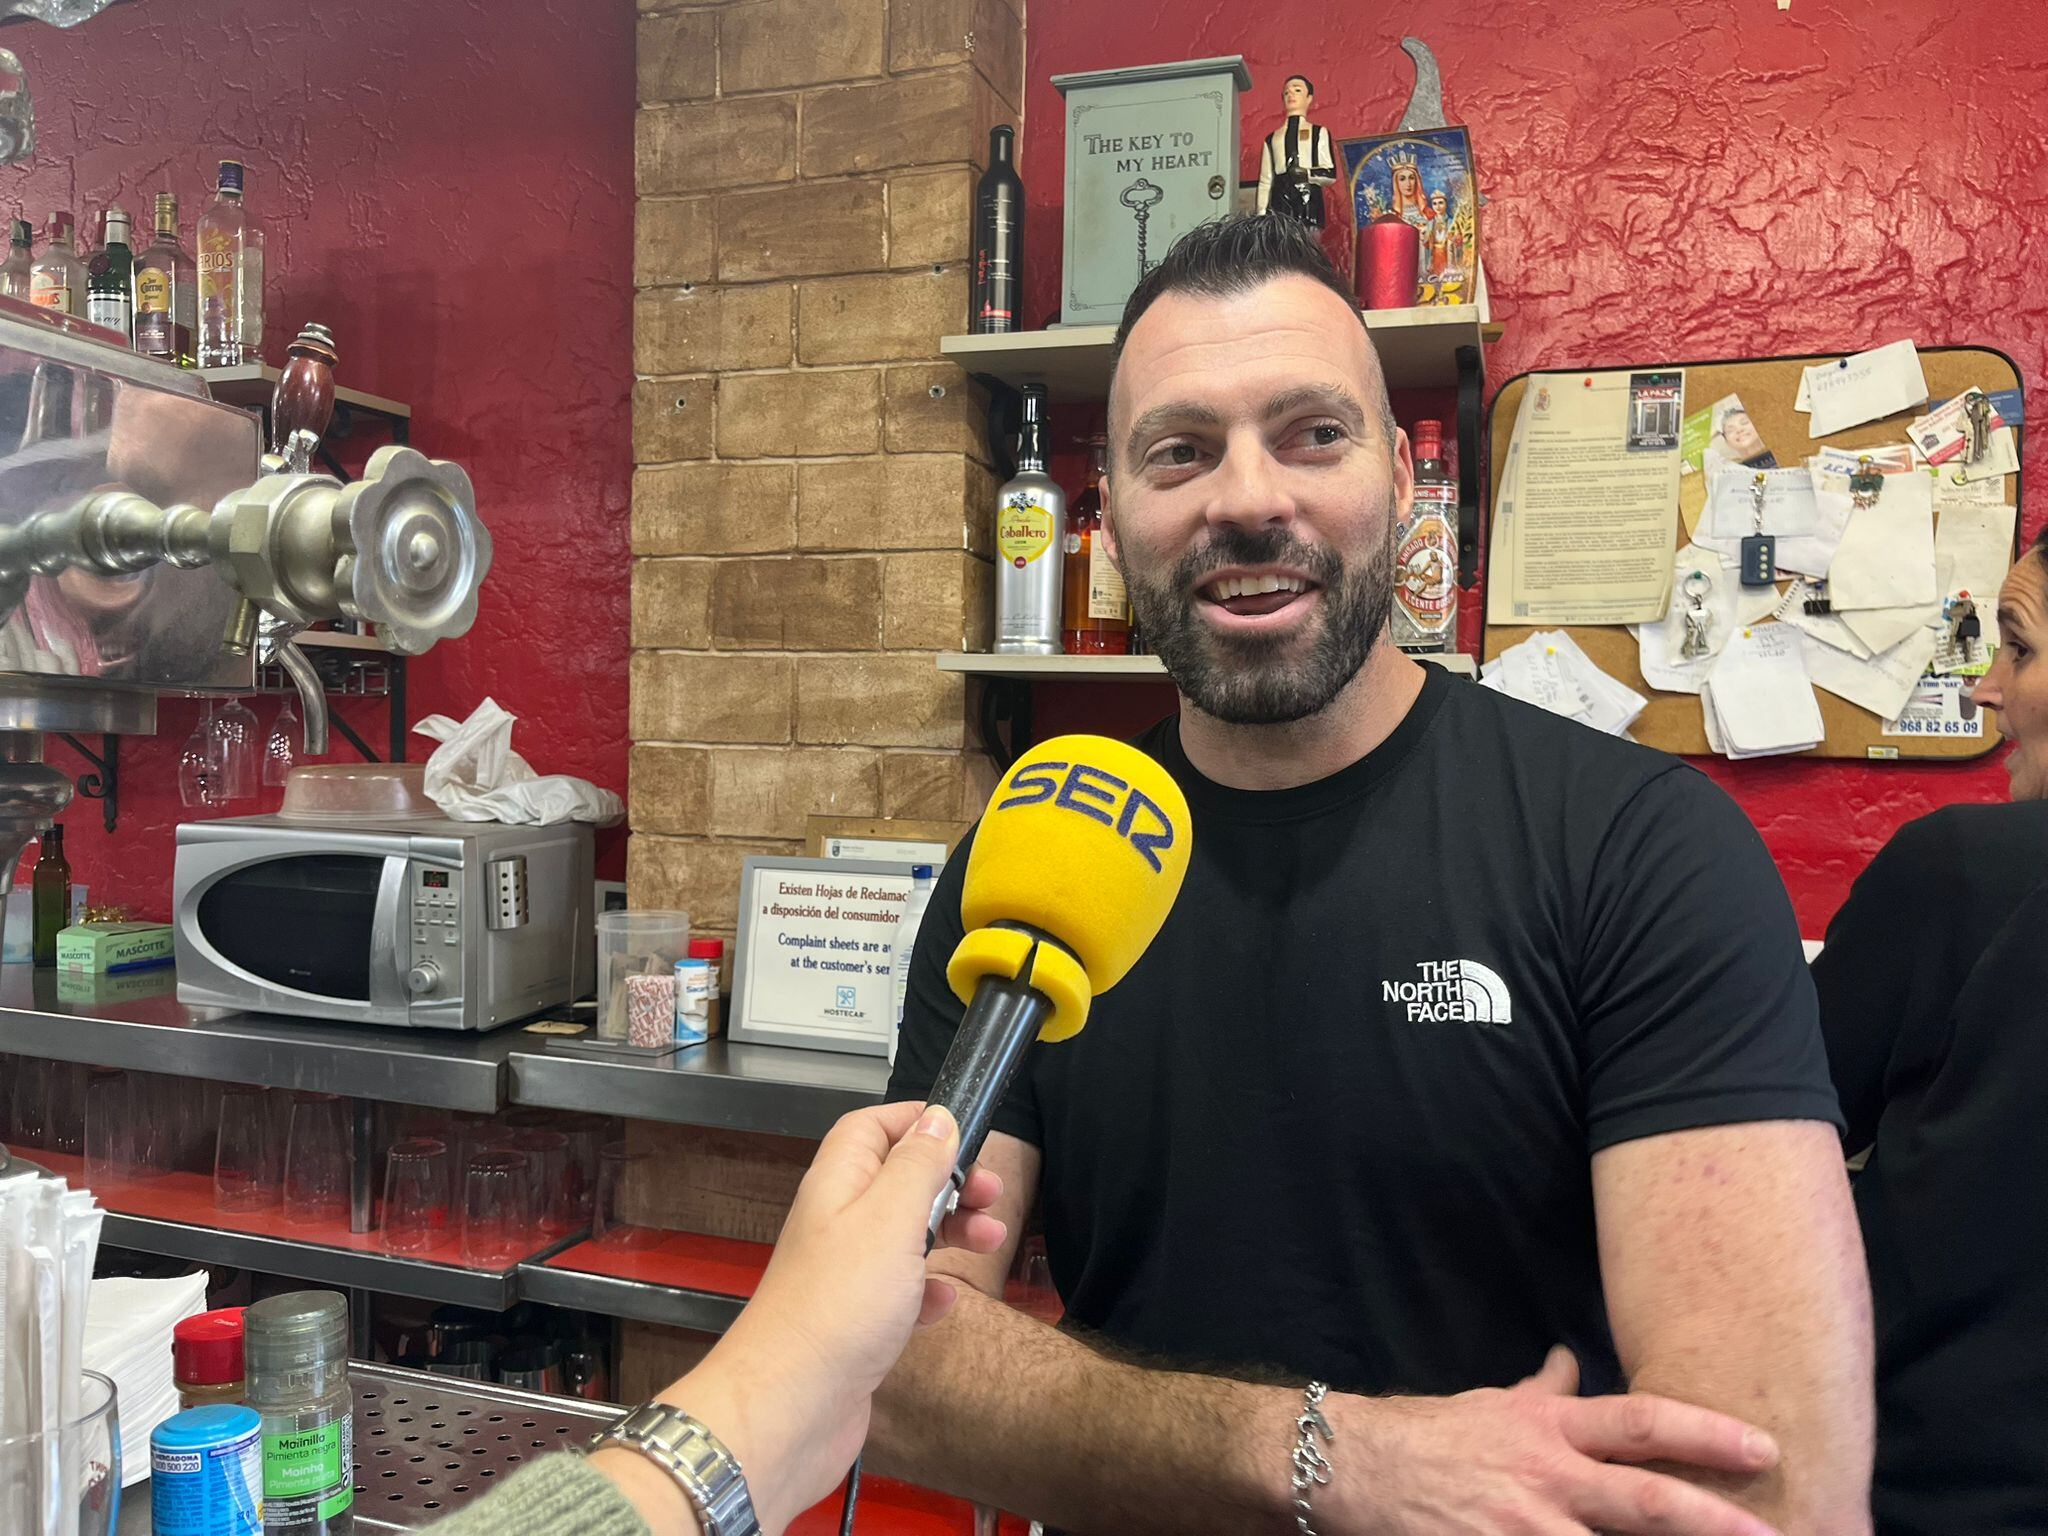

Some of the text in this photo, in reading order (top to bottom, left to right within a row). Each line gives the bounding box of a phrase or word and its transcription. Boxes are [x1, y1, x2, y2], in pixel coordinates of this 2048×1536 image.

[1083, 132, 1194, 155] THE KEY TO
[1116, 151, 1213, 173] MY HEART
[1000, 525, 1047, 539] Caballero
[1404, 589, 1434, 610] VICENTE
[1900, 721, 1978, 733] 968 82 65 09
[997, 761, 1174, 874] SER
[779, 882, 911, 902] Existen Hojas de Reclamac
[762, 902, 900, 923] a disposición del consumidor
[116, 940, 165, 959] MASCOTTE
[778, 932, 827, 949] Complaint
[829, 936, 860, 951] sheets
[862, 942, 879, 953] are
[60, 952, 91, 960] MASCOTTE
[790, 957, 800, 968] at
[803, 956, 818, 970] the
[820, 957, 872, 974] customer's
[1416, 960, 1460, 982] THE
[1381, 979, 1462, 1002] NORTH
[823, 1008, 865, 1018] HOSTECAR
[1406, 1001, 1464, 1023] FACE
[266, 1440, 337, 1462] Pimienta negra
[278, 1433, 326, 1451] Molinillo
[167, 1461, 182, 1472] 500
[182, 1461, 199, 1472] 220
[282, 1462, 325, 1478] Moinho
[269, 1477, 311, 1489] Pimenta
